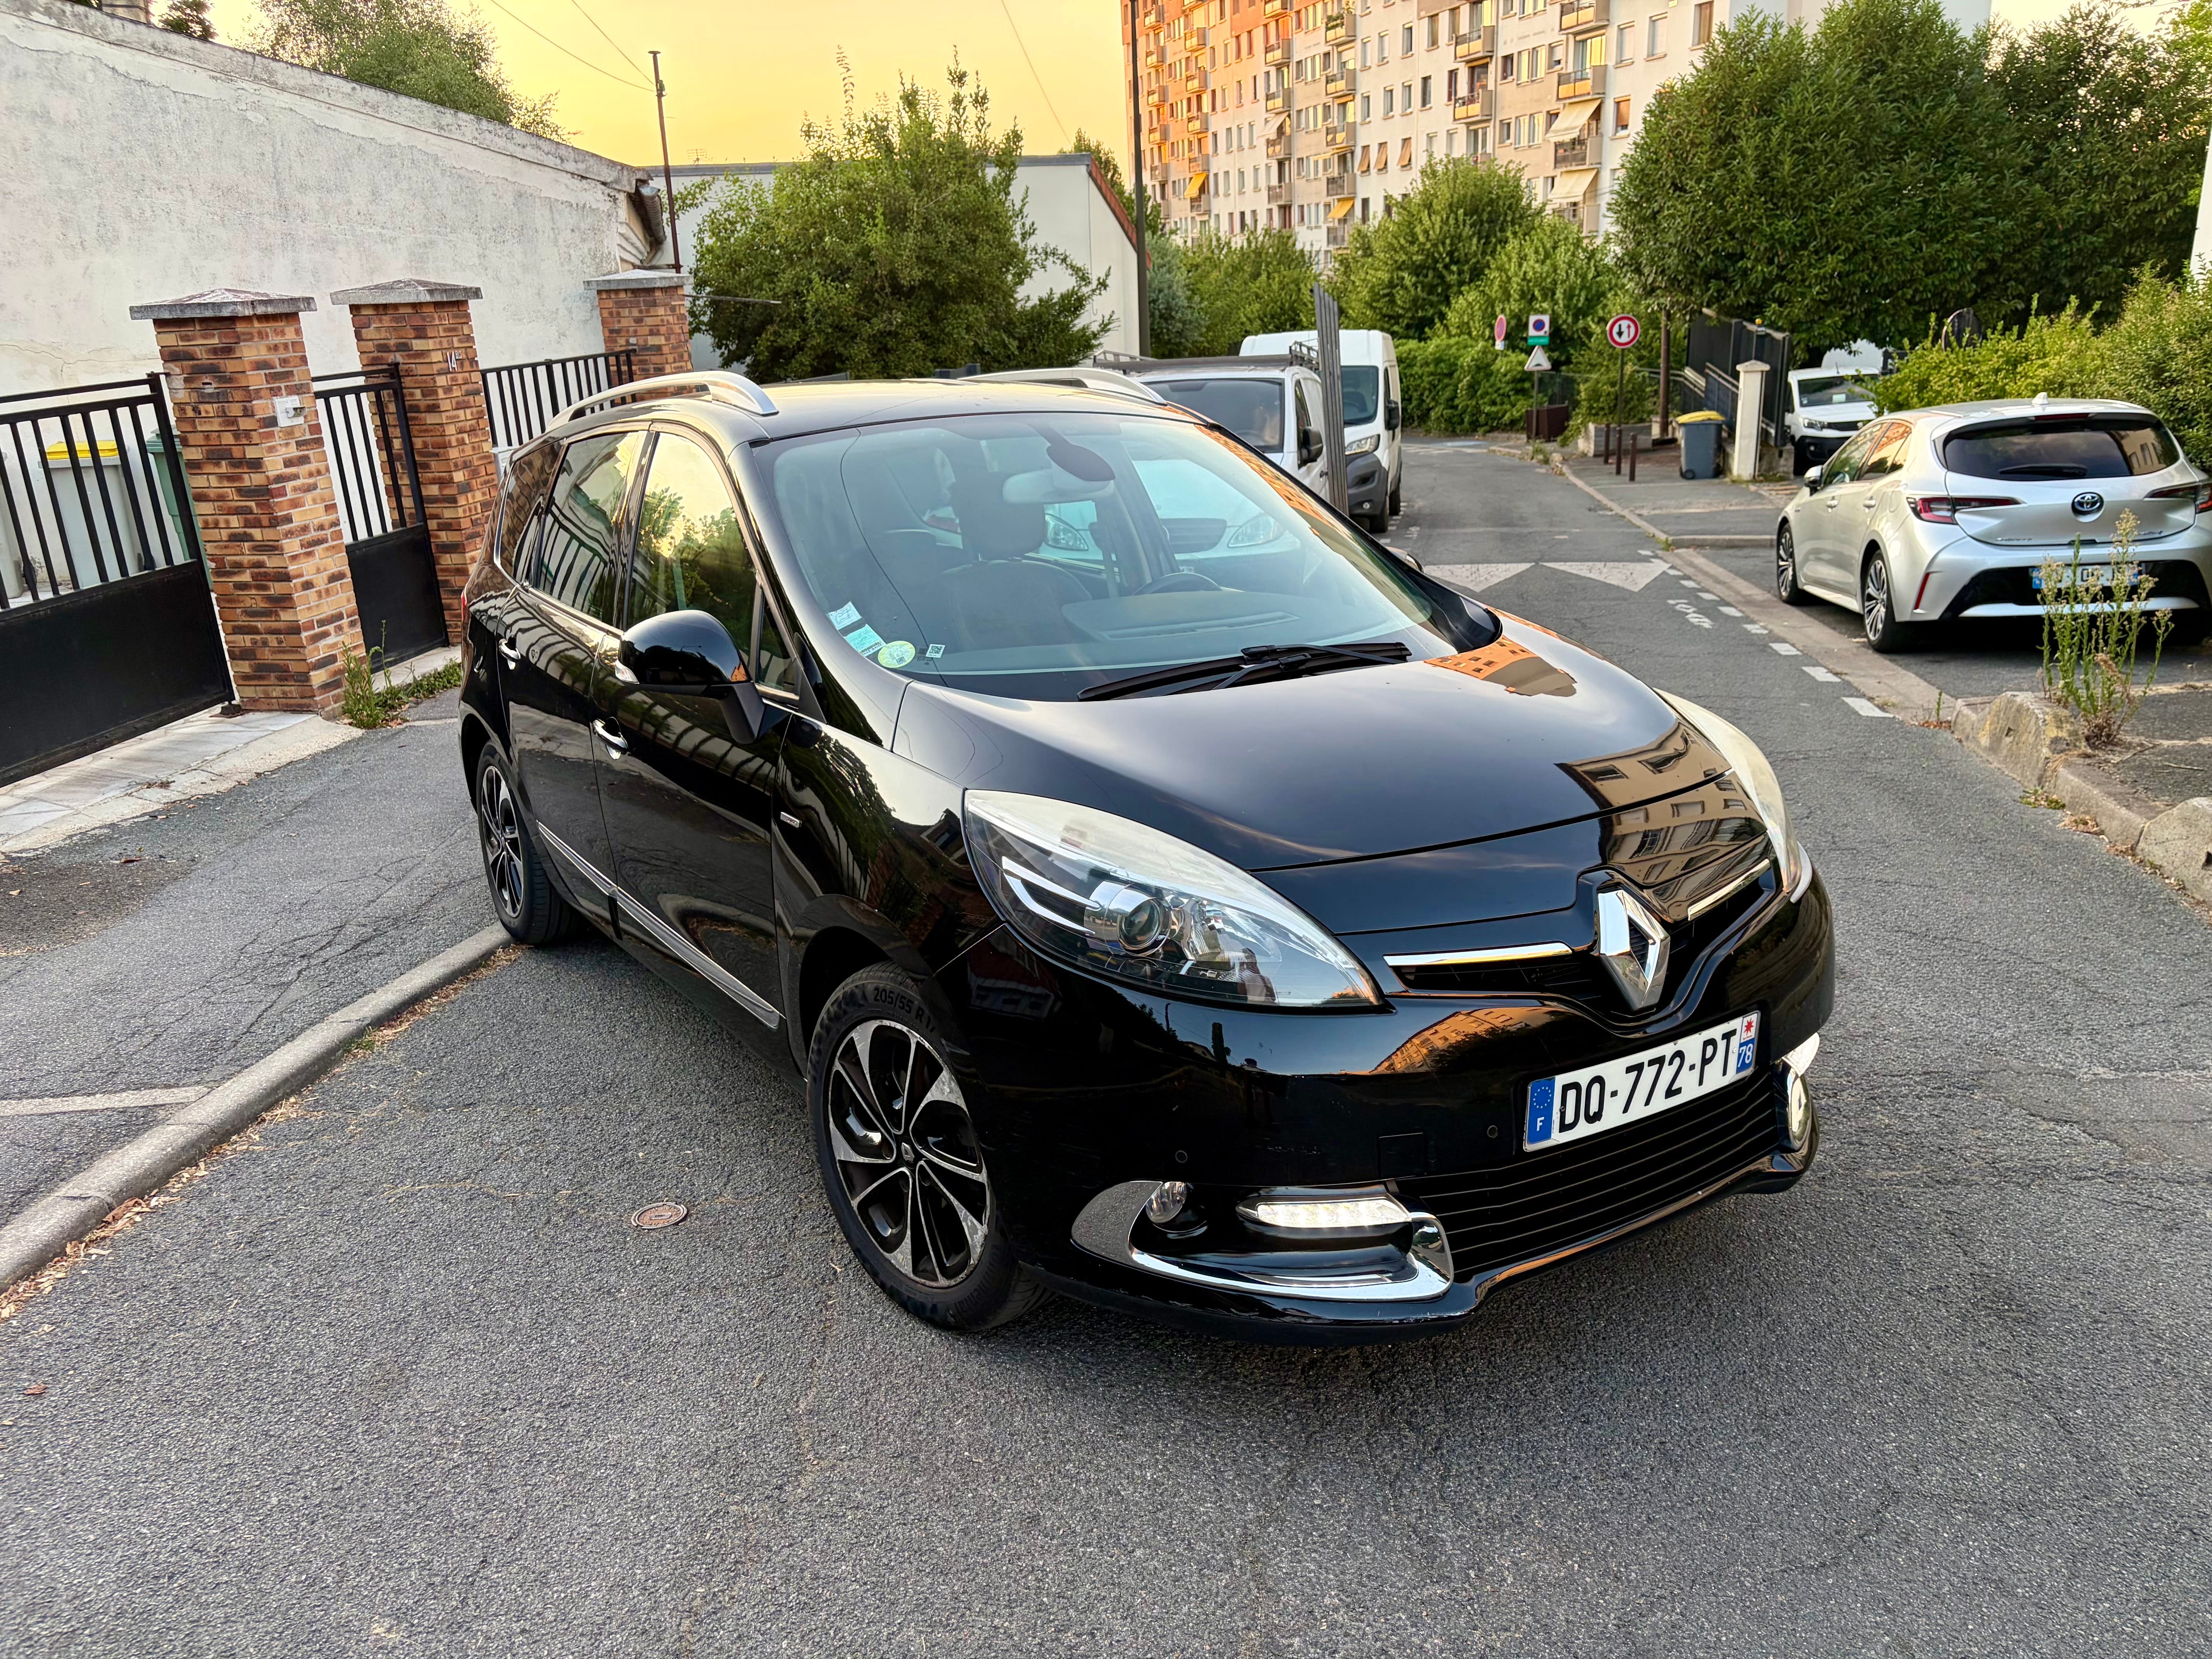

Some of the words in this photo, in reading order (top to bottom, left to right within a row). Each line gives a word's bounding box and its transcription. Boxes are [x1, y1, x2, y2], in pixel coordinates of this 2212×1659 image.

[447, 350, 457, 372] 14
[873, 987, 914, 1014] 205/55
[1737, 1043, 1753, 1068] 78
[1559, 1028, 1737, 1133] DQ-772-PT
[1536, 1116, 1545, 1132] F
